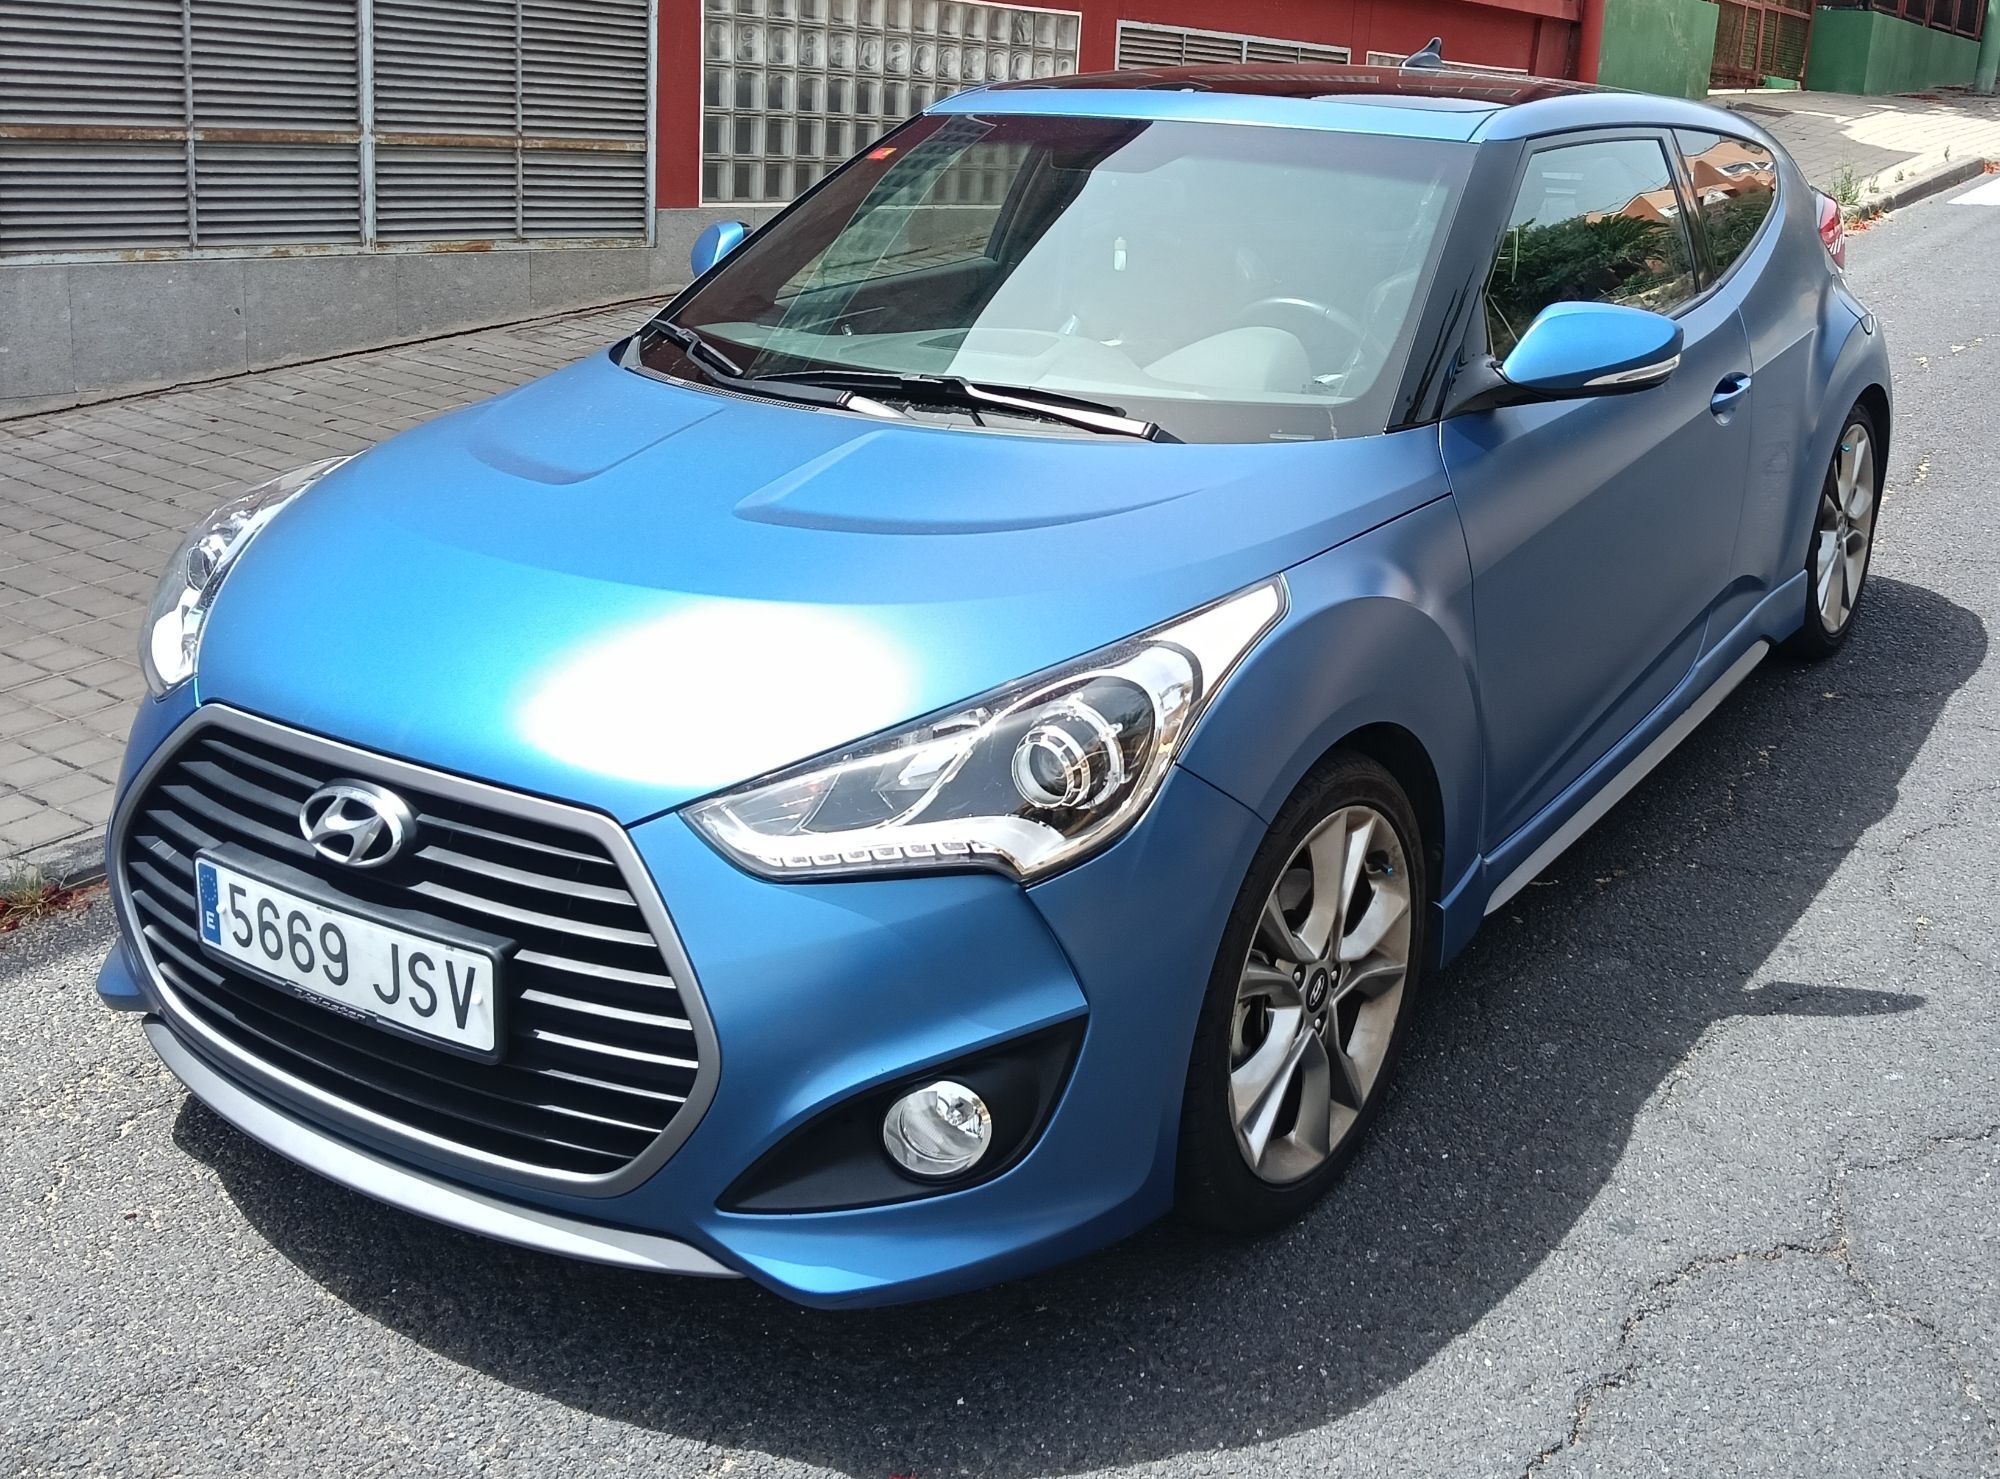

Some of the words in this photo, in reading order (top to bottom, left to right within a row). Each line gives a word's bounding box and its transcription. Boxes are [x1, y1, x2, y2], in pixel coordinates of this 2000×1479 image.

[206, 910, 215, 930] E
[228, 882, 349, 986] 5669
[373, 943, 476, 1030] JSV
